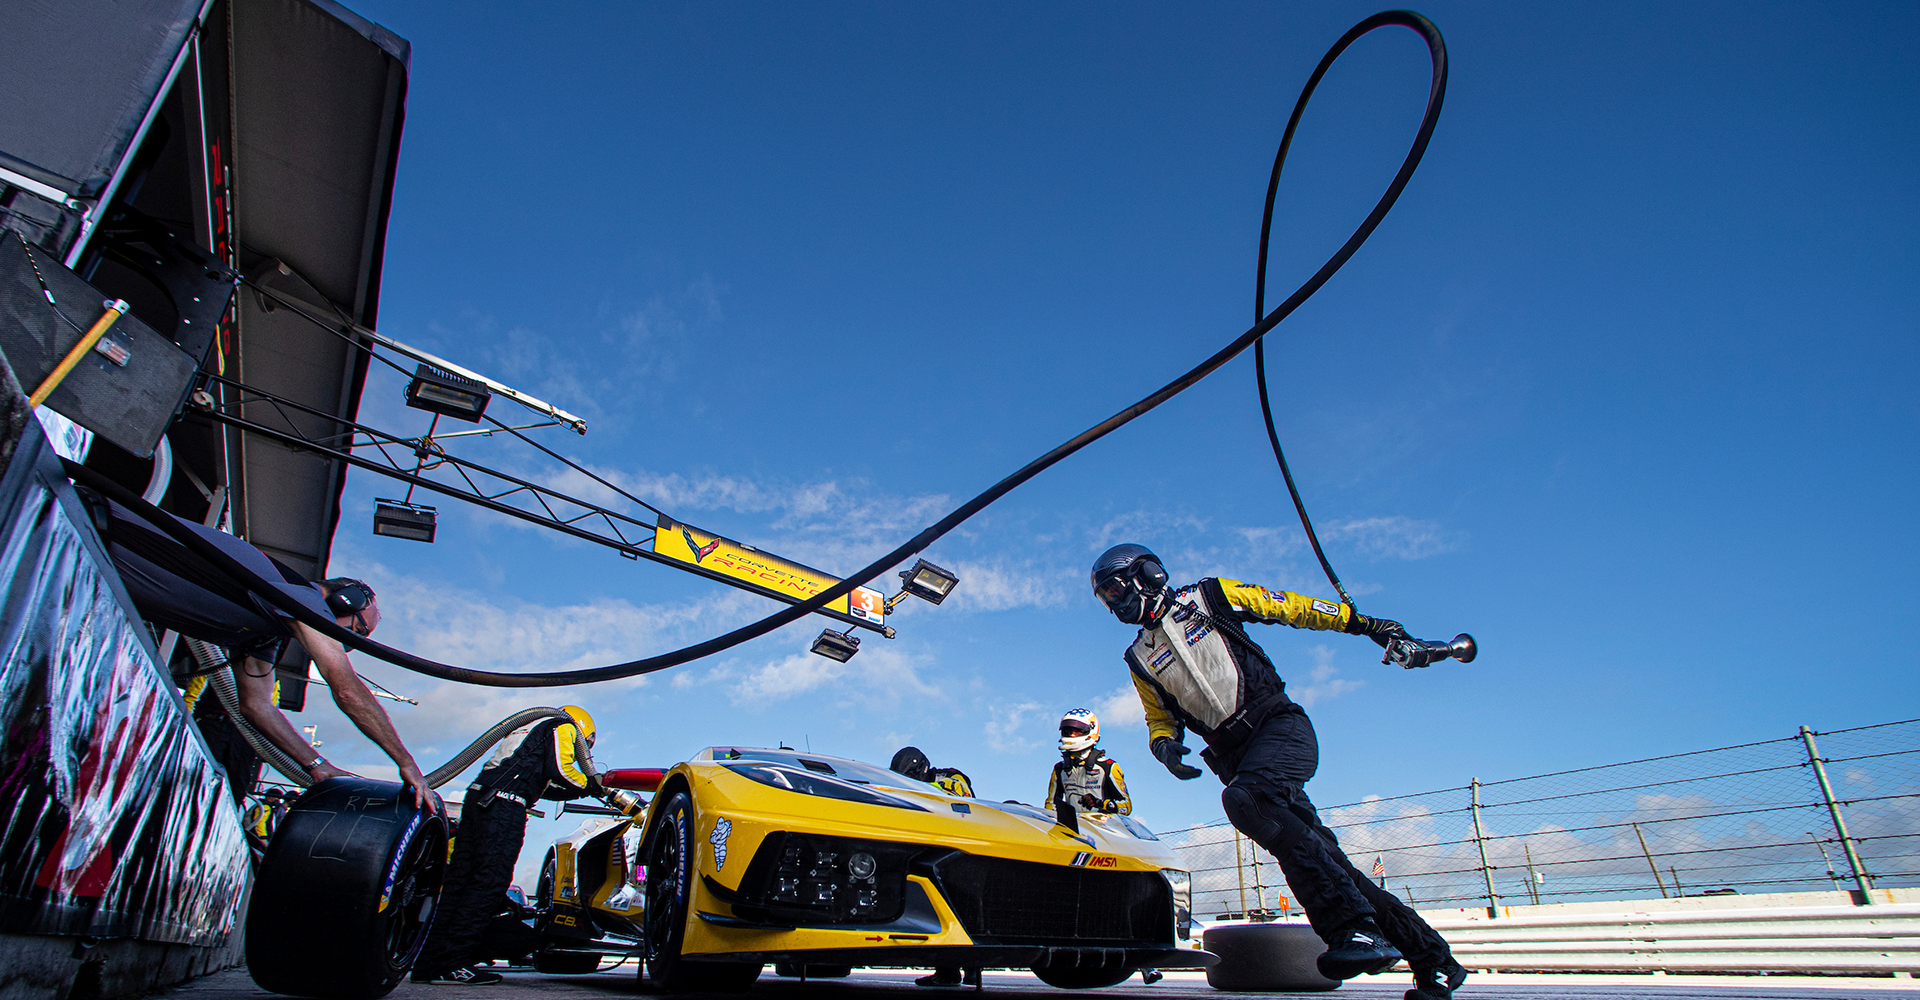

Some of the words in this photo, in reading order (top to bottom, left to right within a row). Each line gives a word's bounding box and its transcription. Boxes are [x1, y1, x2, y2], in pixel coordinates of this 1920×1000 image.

[726, 553, 820, 588] CORVETTE
[860, 592, 875, 612] 3
[1186, 629, 1208, 647] Mobil
[388, 814, 421, 882] MICHELIN
[676, 828, 686, 897] MICHELIN
[1088, 856, 1118, 868] IMSA
